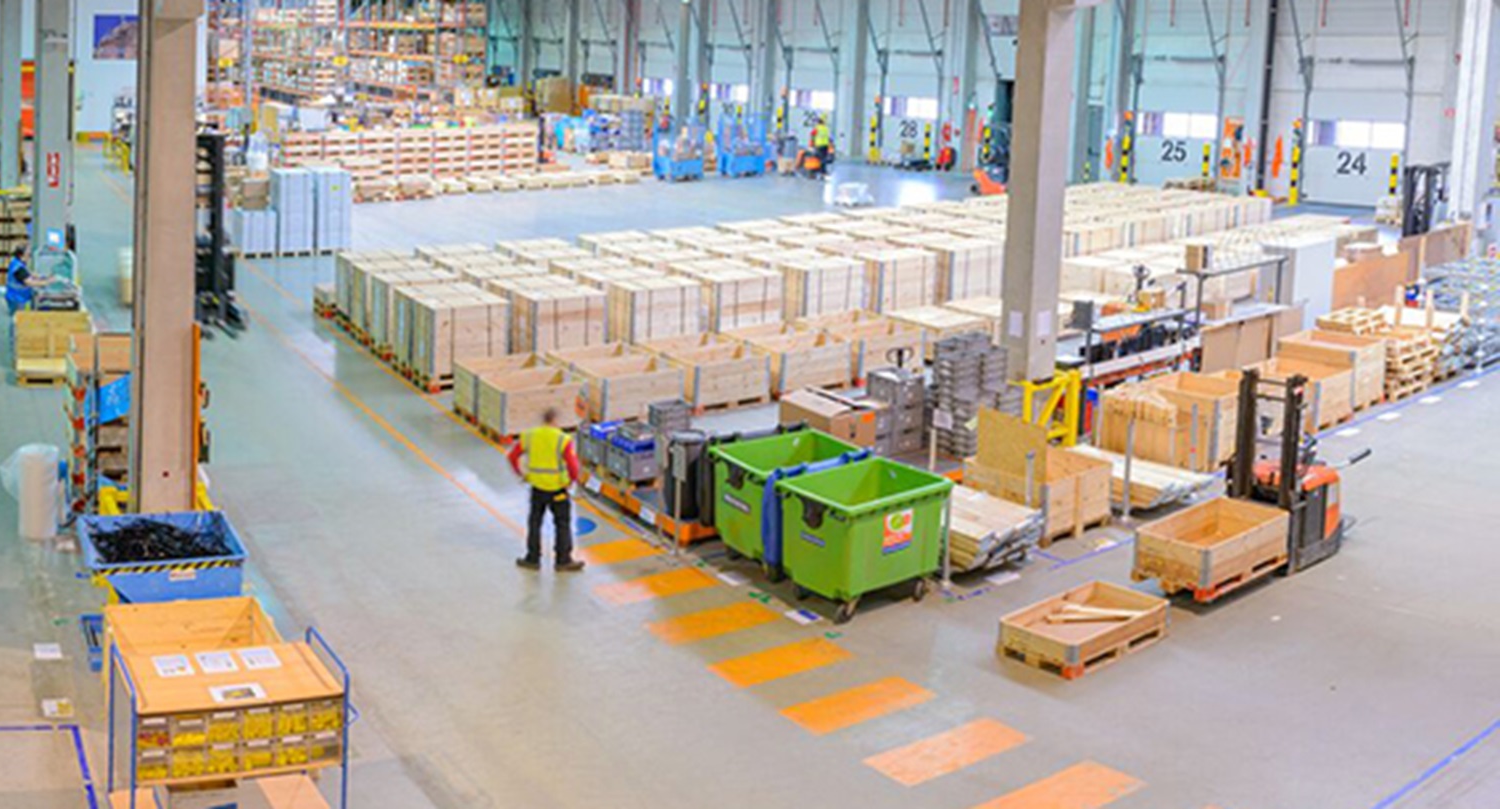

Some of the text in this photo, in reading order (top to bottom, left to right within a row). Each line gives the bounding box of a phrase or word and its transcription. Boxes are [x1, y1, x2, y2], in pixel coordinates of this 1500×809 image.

[900, 119, 918, 138] 28
[1161, 139, 1187, 162] 25
[1337, 150, 1367, 175] 24
